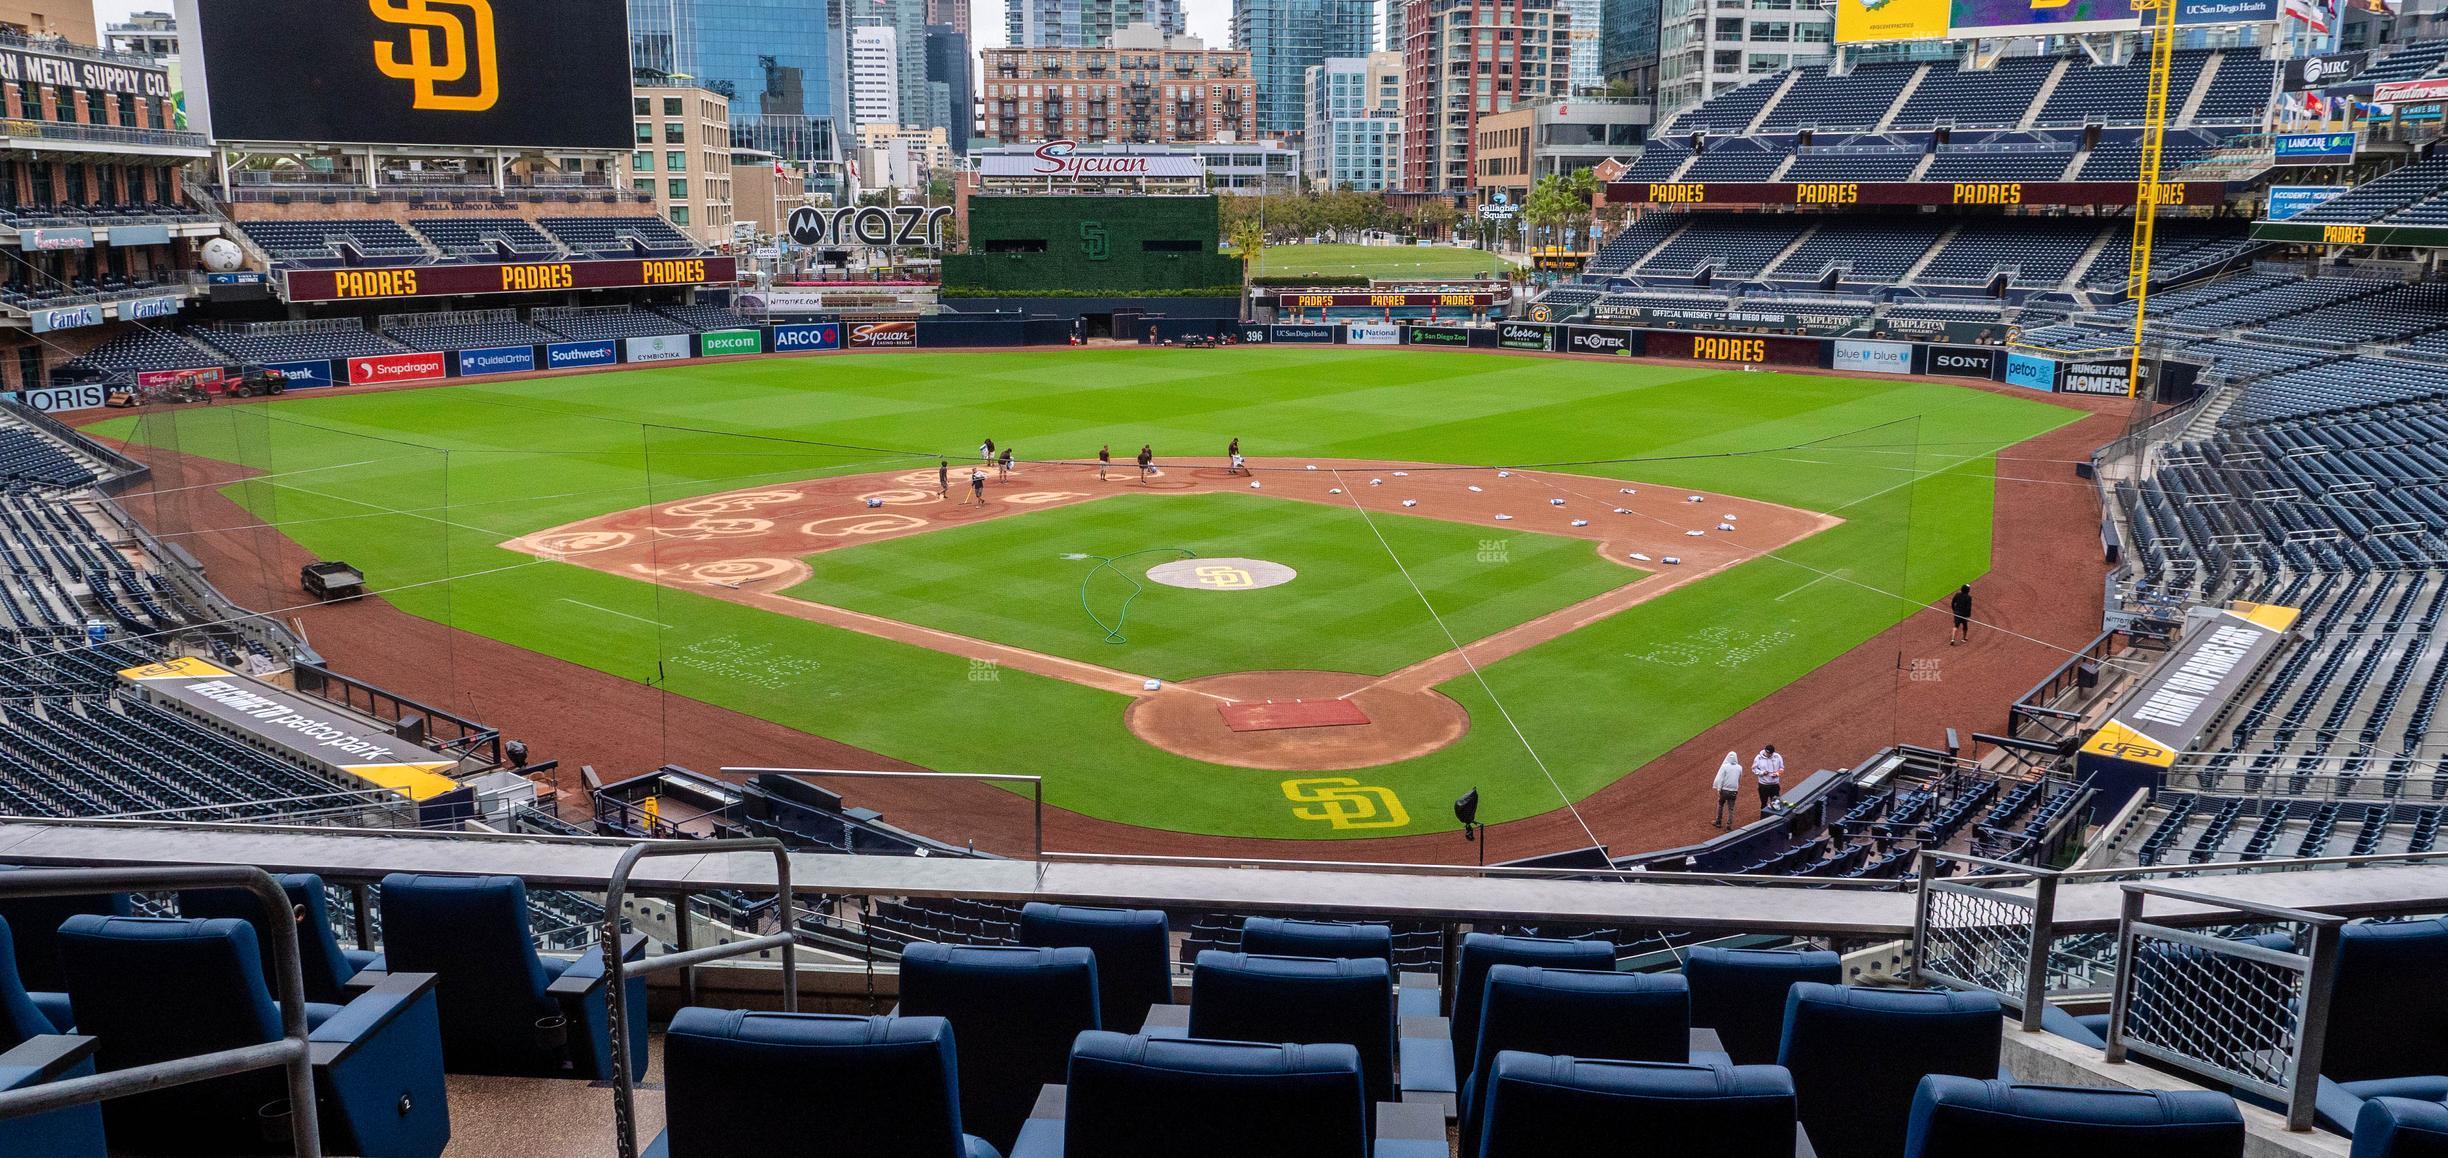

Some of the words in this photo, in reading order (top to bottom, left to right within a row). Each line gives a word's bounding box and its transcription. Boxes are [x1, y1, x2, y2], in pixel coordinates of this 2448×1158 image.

[2187, 5, 2199, 14] UC
[2201, 4, 2215, 13] San
[2216, 3, 2239, 13] Diego
[2240, 2, 2266, 11] Health
[2322, 60, 2350, 74] MRC
[25, 56, 81, 88] METAL
[83, 64, 139, 94] SUPPLY
[145, 73, 169, 97] CO.
[2288, 137, 2326, 148] LANDCARE
[1033, 140, 1150, 183] Sycuan
[1649, 184, 1704, 203] PADRES
[1797, 184, 1857, 203] PADRES
[1953, 183, 2022, 205] PADRES
[1478, 204, 1519, 214] Gallagher
[831, 205, 953, 247] razr
[2323, 225, 2367, 244] PADRES
[502, 264, 573, 291] PADRES
[642, 260, 706, 284] PADRES
[335, 269, 417, 298] PADRES
[1299, 295, 1334, 306] PADRES
[1440, 295, 1475, 306] PADRES
[132, 299, 170, 318] Canel's
[1593, 306, 1641, 317] TEMPLETON
[1652, 309, 1682, 319] OFFICIAL
[1682, 310, 1713, 320] WHISKEY
[1728, 312, 1741, 321] SAN
[1742, 314, 1760, 322] DIEGO
[1761, 315, 1785, 323] PADRES
[48, 308, 92, 329] Canel's
[1796, 315, 1851, 327] TEMPLETON
[1887, 319, 1946, 331] TEMPLETON
[776, 331, 821, 346] ARCO
[852, 324, 910, 346] Sycuan
[1246, 331, 1263, 342] 396
[1365, 329, 1396, 337] National
[1436, 333, 1454, 341] Diego
[1503, 325, 1542, 339] Chosen
[1574, 333, 1625, 349] EVOTEK
[552, 348, 605, 362] Southwest
[637, 352, 680, 361] CYMBIOTIKA
[1693, 336, 1766, 362] PADRES
[1836, 348, 1860, 359] blue
[1873, 351, 1898, 361] blue
[377, 361, 439, 375] Snapdragon
[477, 354, 531, 367] QuidelOrtho
[1937, 355, 1989, 369] SONY
[2008, 362, 2037, 377] petco
[2071, 364, 2107, 375] HUNGRY
[2108, 365, 2127, 376] FOR
[2065, 375, 2130, 395] HOMERS
[30, 386, 101, 412] ORIS
[2207, 625, 2263, 648] FANS
[2176, 643, 2247, 679] PADRES
[2160, 675, 2219, 696] YOU
[184, 680, 270, 713] WELCOME
[252, 701, 284, 719] TO
[2132, 689, 2204, 727] THANK
[267, 710, 344, 741] petco
[319, 735, 394, 760] park
[404, 1099, 411, 1109] 2
